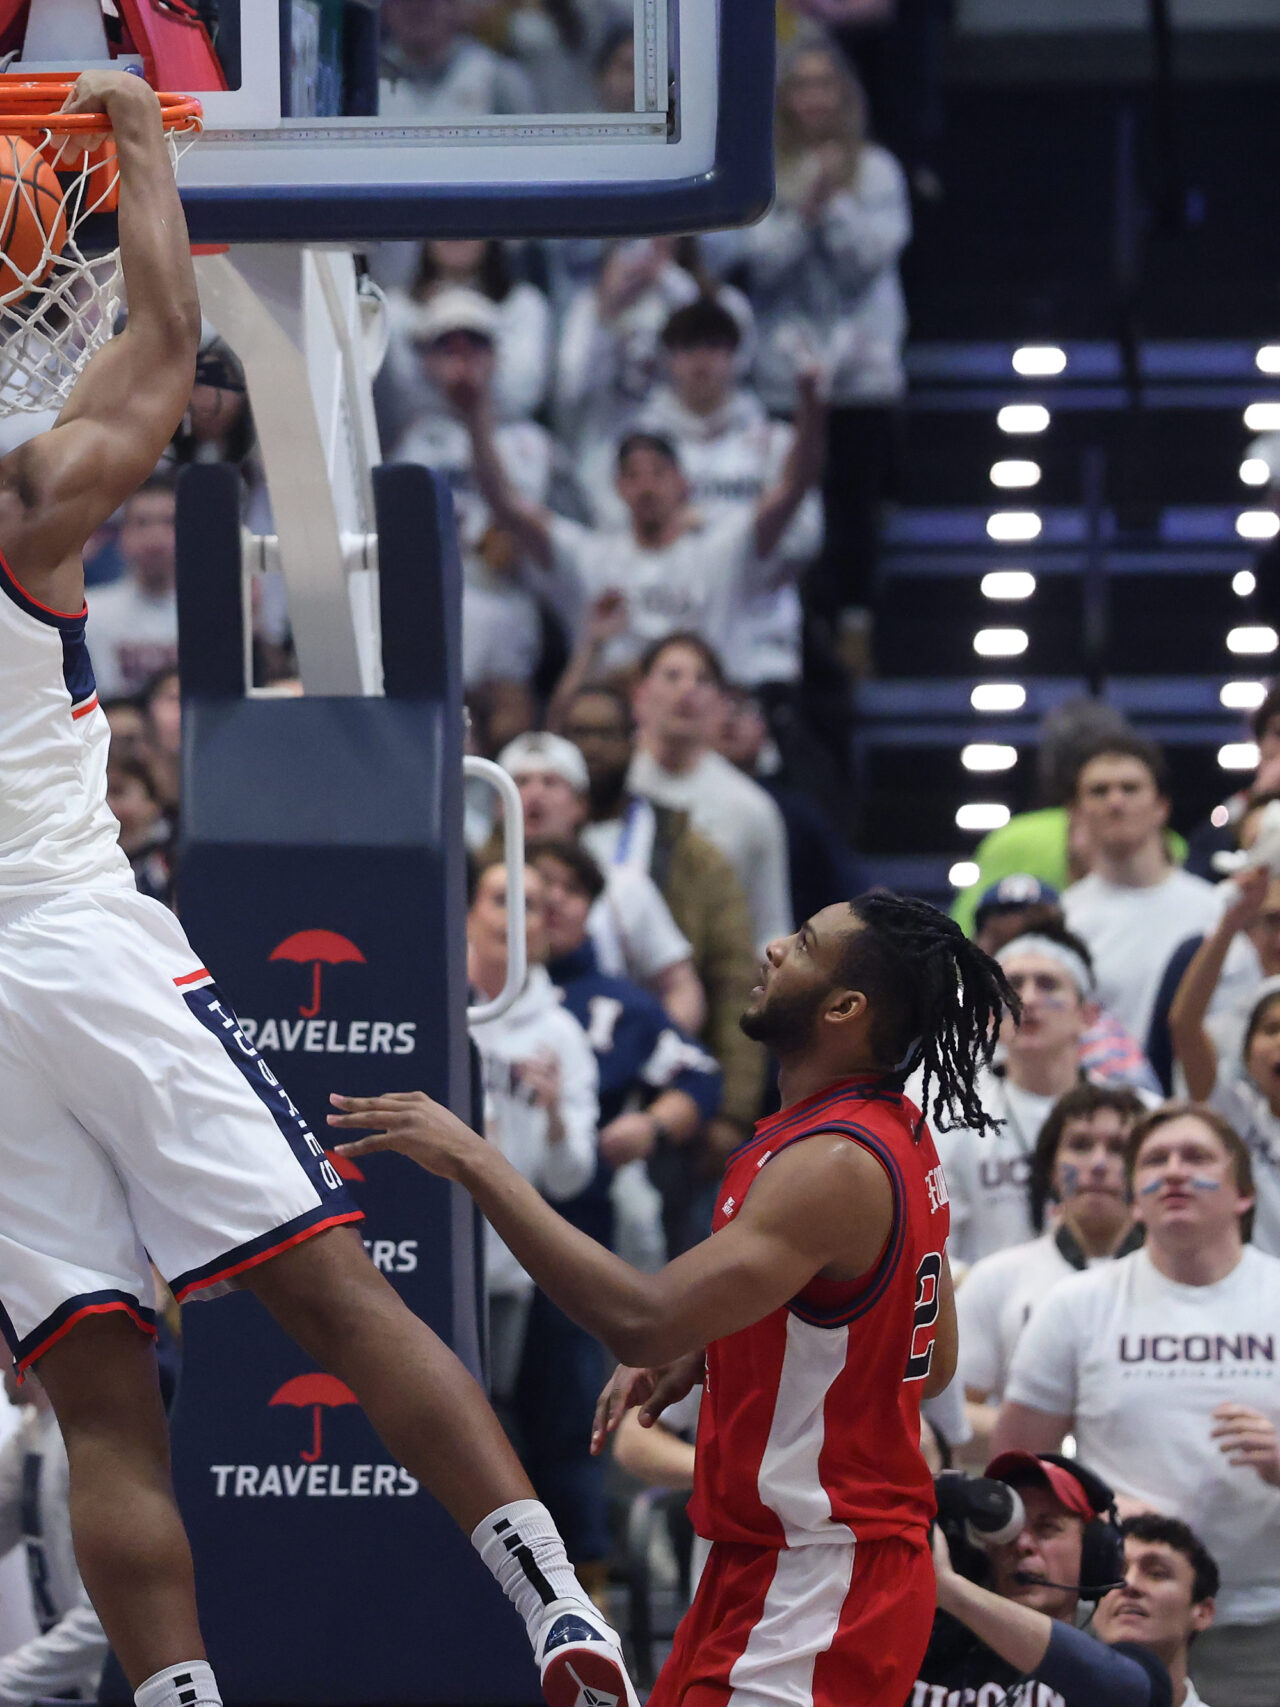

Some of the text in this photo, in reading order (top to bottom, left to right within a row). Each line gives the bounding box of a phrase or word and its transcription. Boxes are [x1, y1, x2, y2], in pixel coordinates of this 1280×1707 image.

[234, 1017, 417, 1054] RAVELERS
[207, 999, 344, 1191] HUSKIES
[1120, 1334, 1275, 1363] UCONN
[210, 1464, 419, 1497] TRAVELERS
